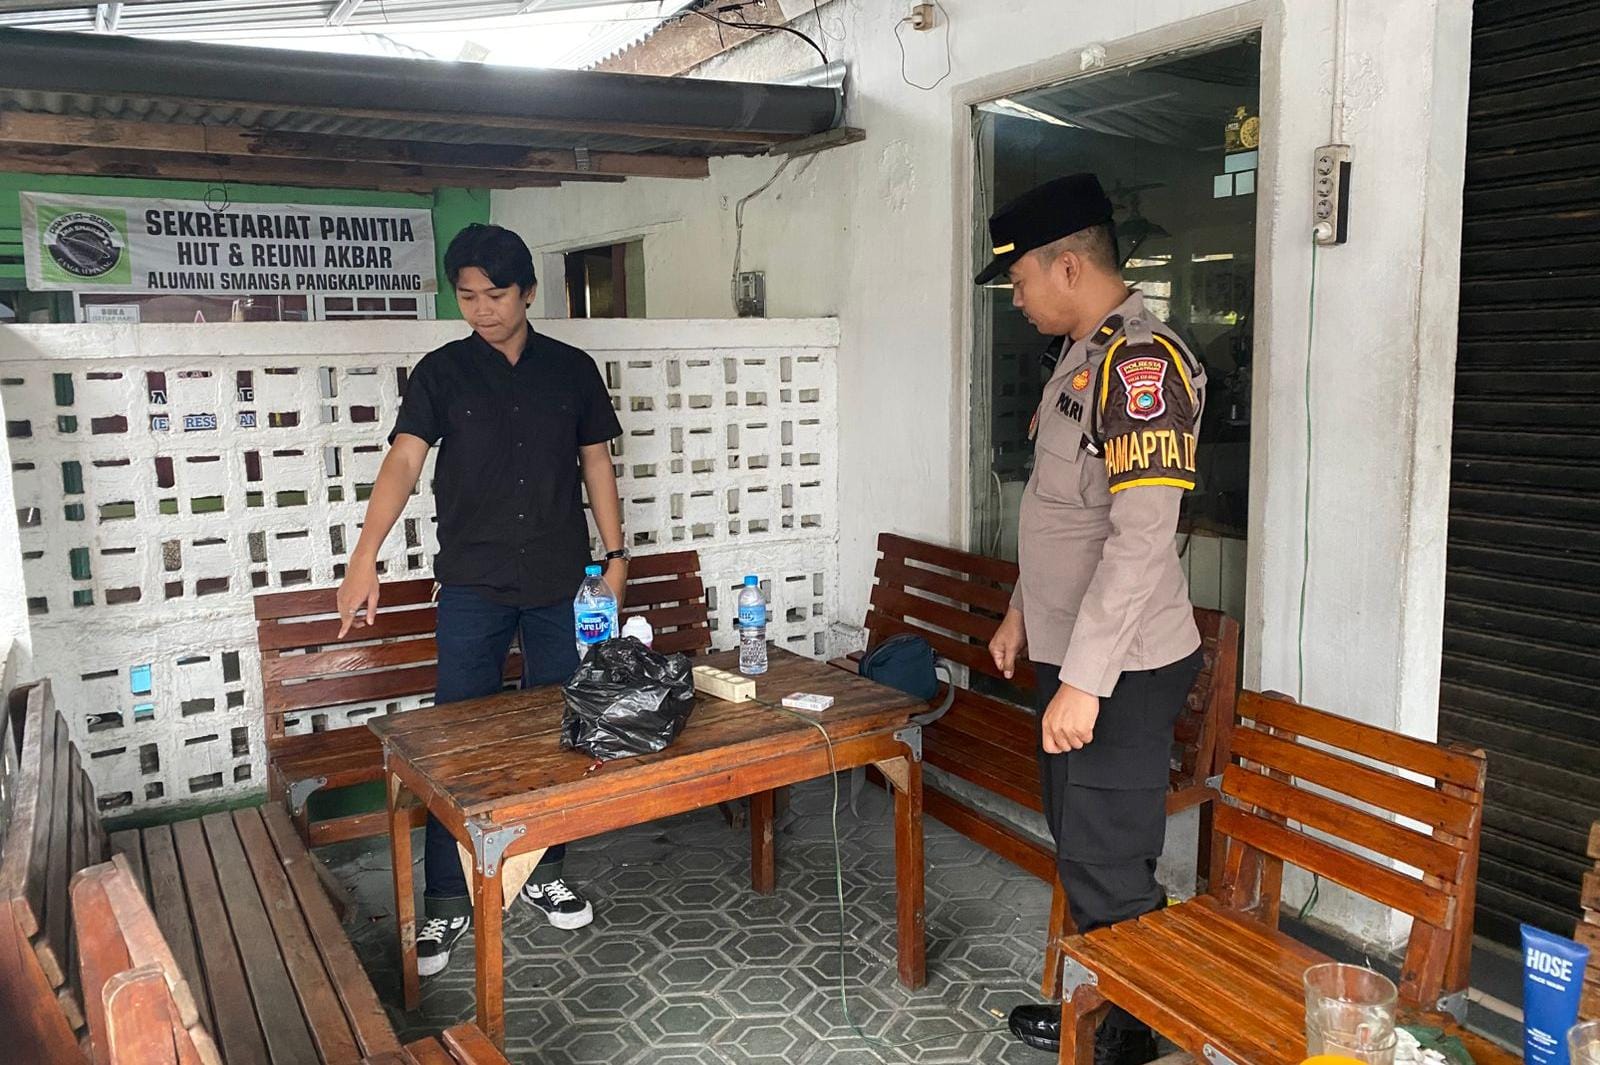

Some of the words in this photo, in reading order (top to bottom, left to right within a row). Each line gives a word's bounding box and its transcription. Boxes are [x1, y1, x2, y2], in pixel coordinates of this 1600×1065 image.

[145, 209, 311, 240] SEKRETARIAT
[320, 216, 415, 242] PANITIA
[178, 242, 219, 267] HUT
[229, 244, 243, 267] &
[252, 243, 317, 268] REUNI
[325, 245, 393, 269] AKBAR
[147, 271, 216, 290] ALUMNI
[220, 272, 291, 291] SMANSA
[296, 273, 422, 291] PANGKALPINANG
[1526, 947, 1573, 982] HOSE
